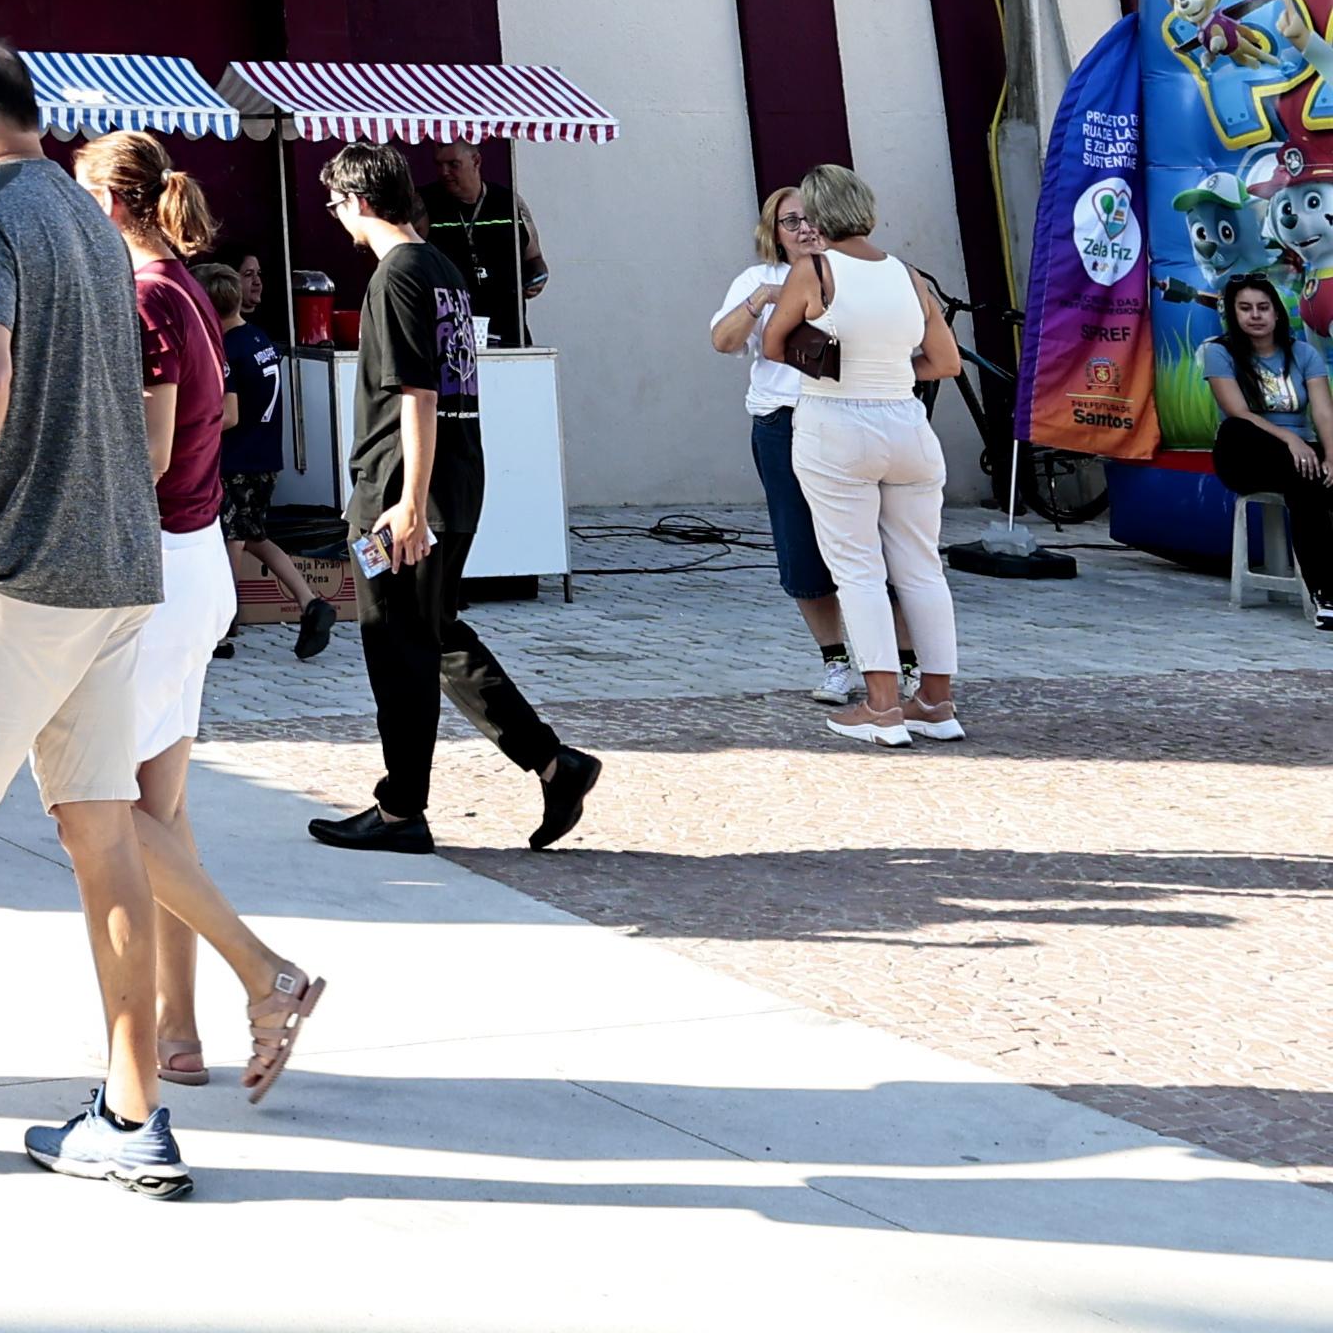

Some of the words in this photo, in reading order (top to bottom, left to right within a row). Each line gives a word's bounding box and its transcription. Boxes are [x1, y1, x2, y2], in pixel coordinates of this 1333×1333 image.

[1084, 138, 1093, 152] E
[1083, 237, 1108, 258] Zela
[260, 364, 281, 423] 7
[1073, 408, 1134, 430] Santos
